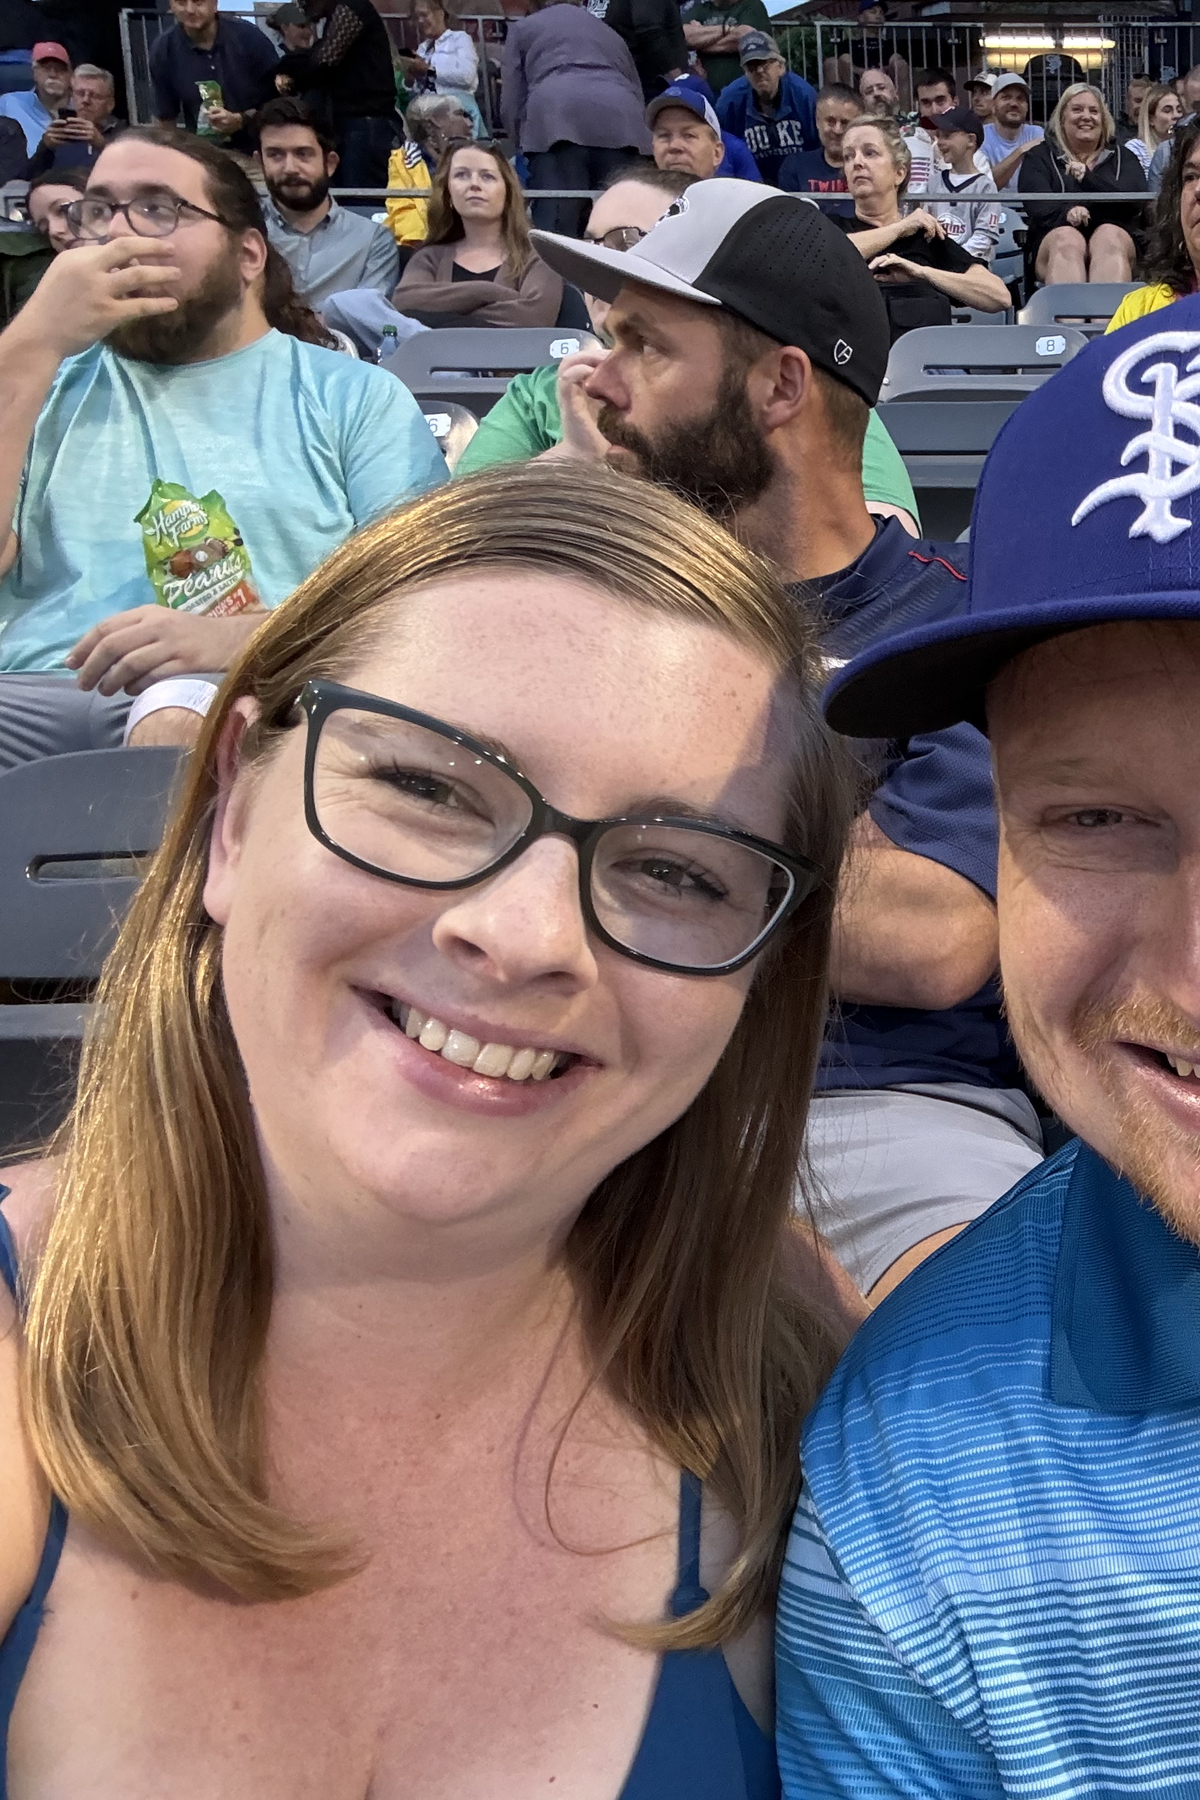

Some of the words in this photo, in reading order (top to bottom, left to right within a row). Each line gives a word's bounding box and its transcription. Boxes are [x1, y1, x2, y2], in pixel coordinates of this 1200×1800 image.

[560, 342, 570, 355] 6
[1046, 339, 1055, 352] 8
[428, 418, 438, 433] 6
[163, 552, 244, 608] Peanuts
[182, 593, 212, 612] OASTED
